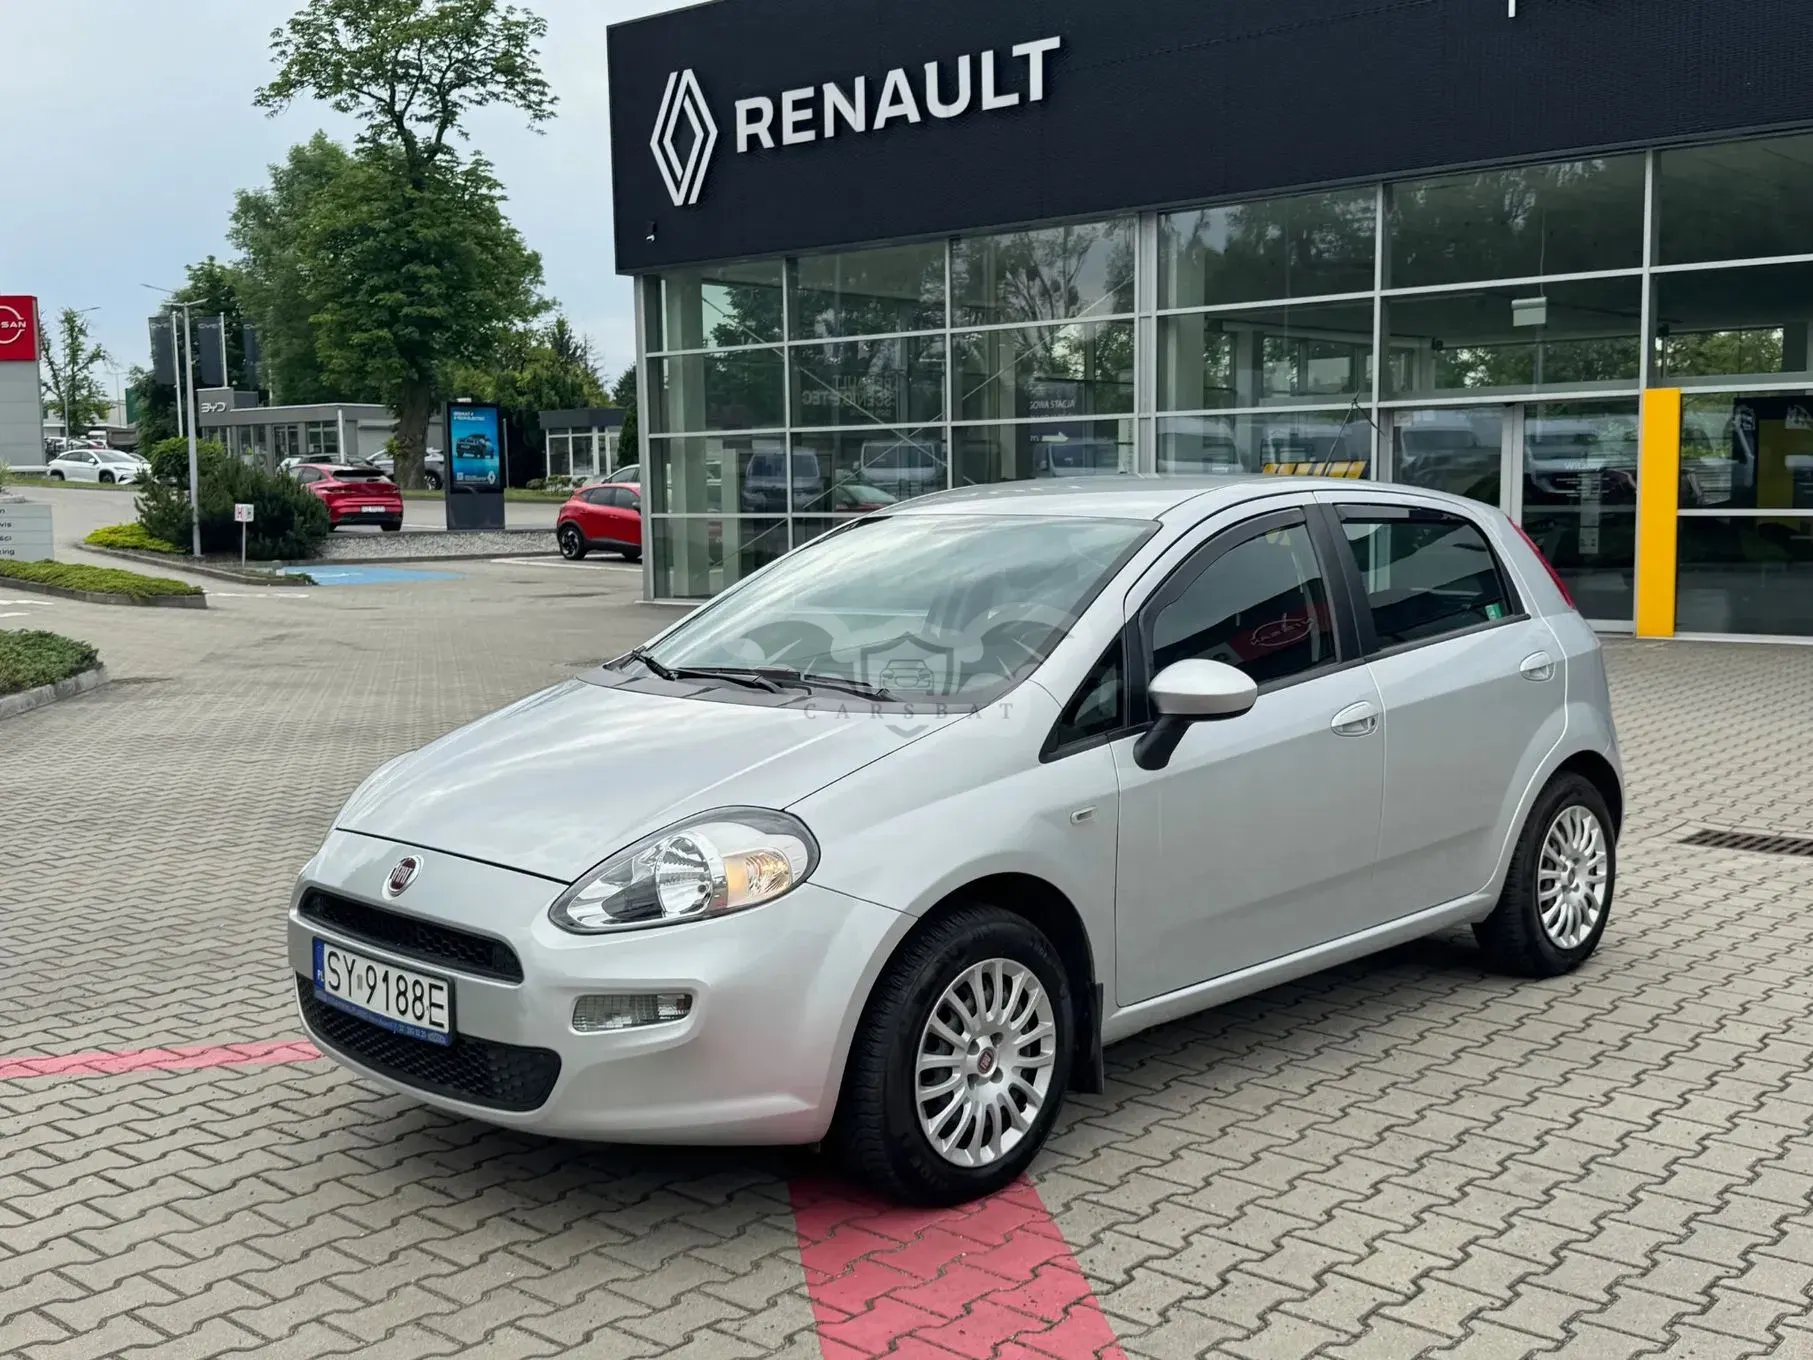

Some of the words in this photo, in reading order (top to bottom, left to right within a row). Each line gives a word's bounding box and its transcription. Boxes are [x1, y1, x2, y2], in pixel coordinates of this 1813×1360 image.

[734, 35, 1061, 153] RENAULT
[201, 402, 226, 413] BYD
[327, 950, 356, 998] SY
[365, 964, 445, 1029] 9188E
